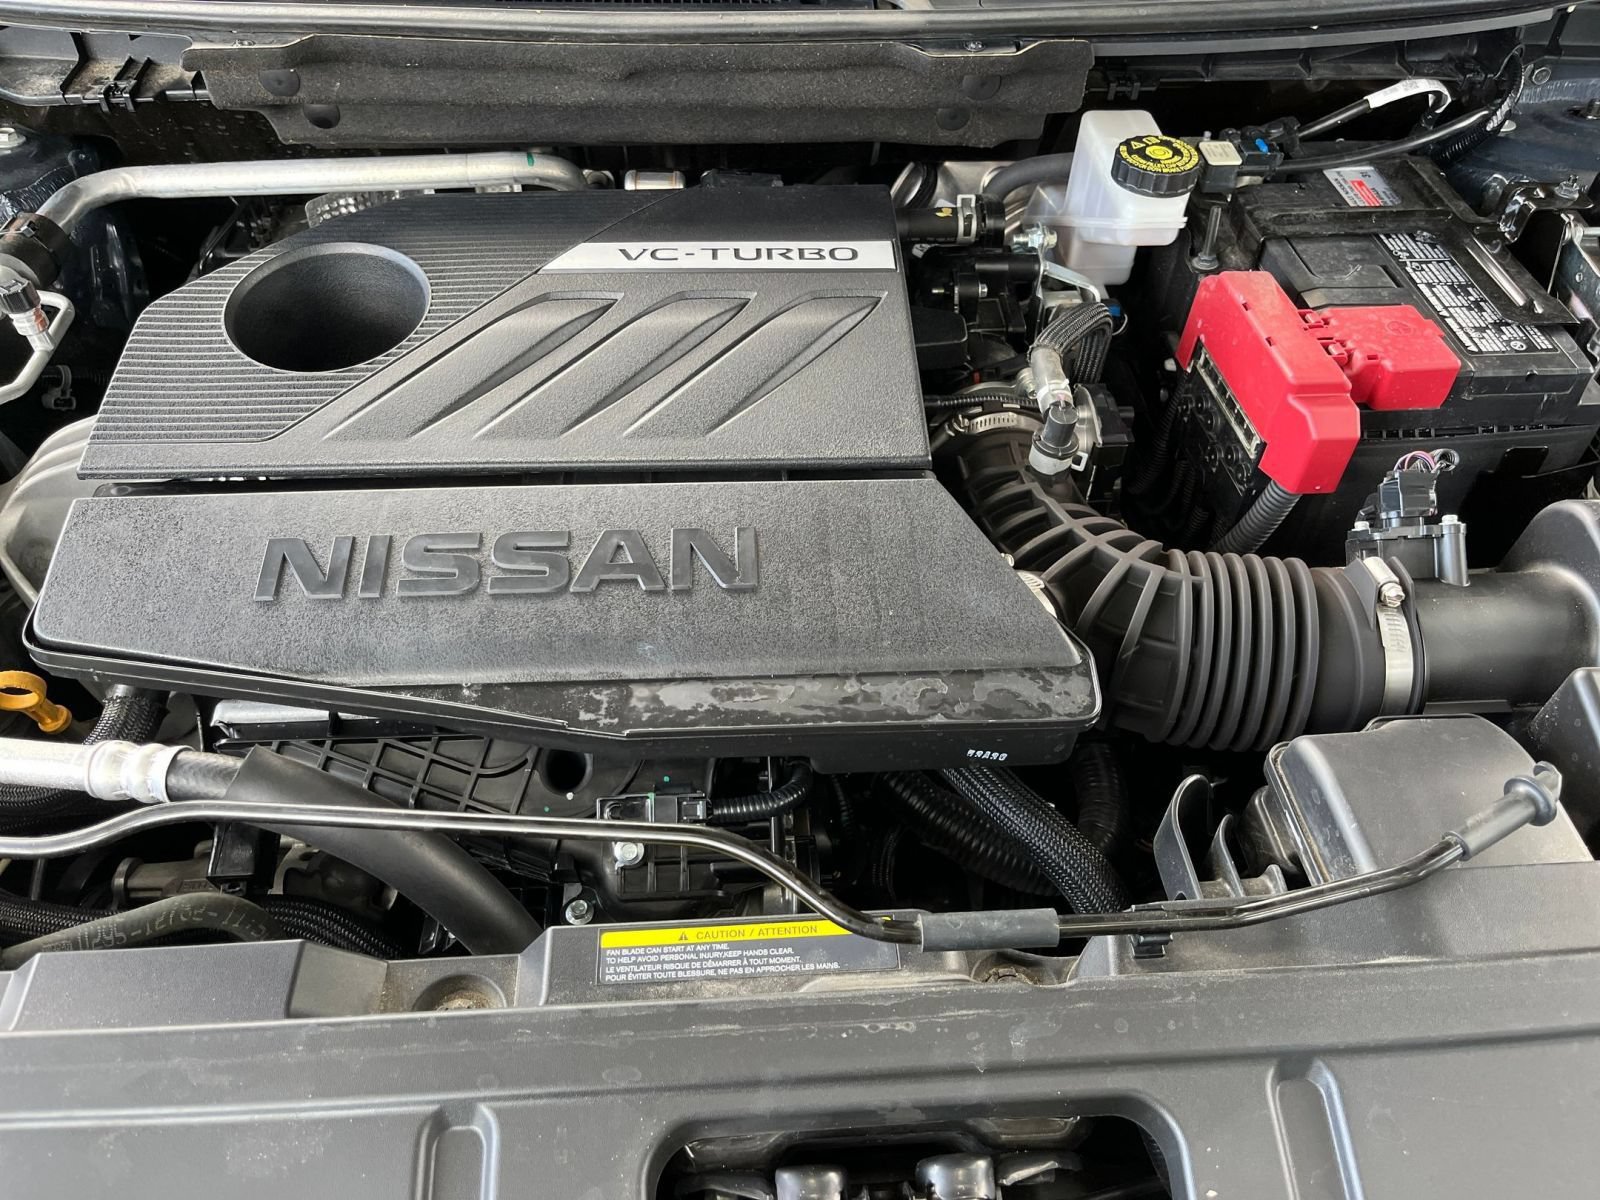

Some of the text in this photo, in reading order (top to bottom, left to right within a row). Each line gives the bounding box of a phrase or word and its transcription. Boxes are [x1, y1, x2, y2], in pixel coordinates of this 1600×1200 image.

[618, 247, 859, 262] VC-TURBO
[253, 526, 758, 601] NISSAN
[696, 928, 745, 940] CAUTION
[758, 925, 818, 936] ATTENTION
[622, 948, 645, 956] BLADE
[637, 954, 659, 962] AVOID
[660, 953, 698, 961] PERSONAL
[743, 948, 768, 956] HANDS
[770, 947, 794, 955] CLEAR.
[616, 964, 662, 973] VENTILATEUR
[703, 958, 742, 968] DÉMARRER
[628, 972, 652, 981] ÉVITER
[678, 969, 716, 978] BLESSURE,
[756, 964, 800, 973] APPROCHER
[816, 962, 840, 970] MAINS.
